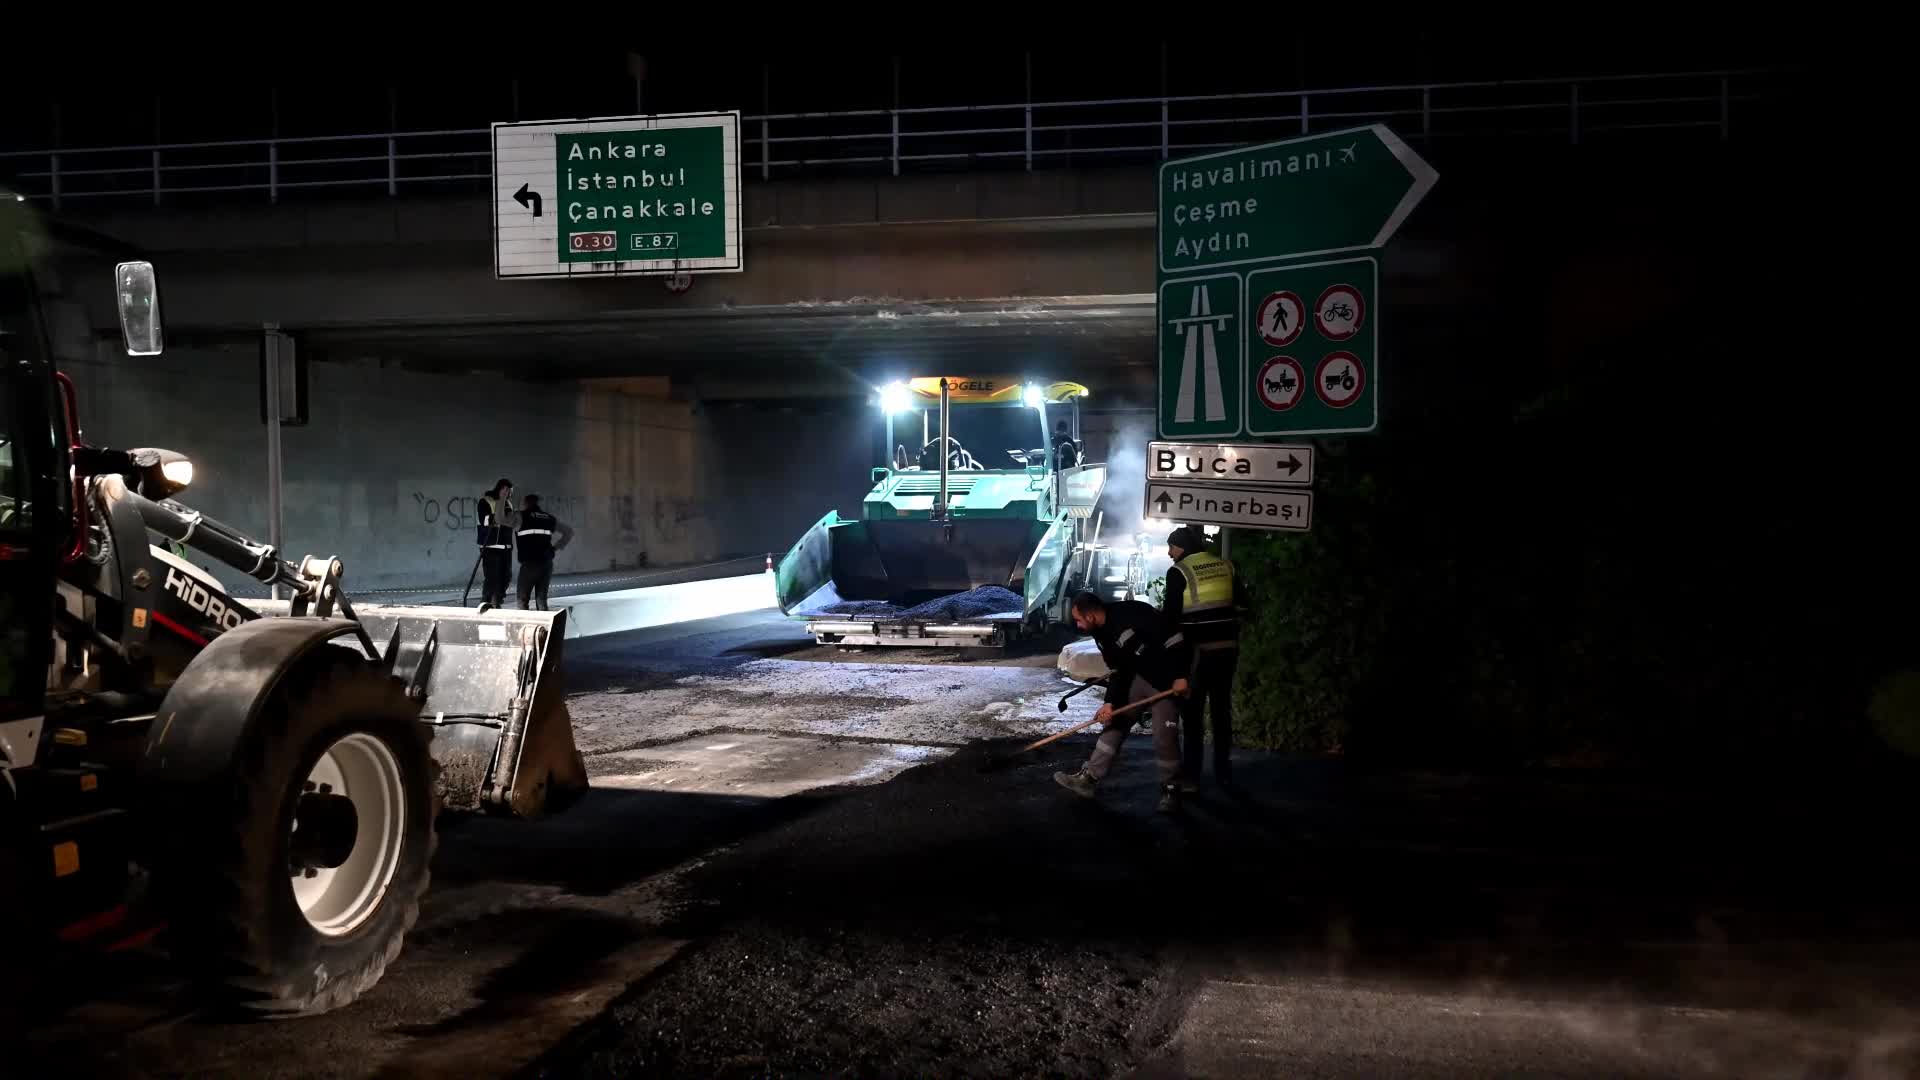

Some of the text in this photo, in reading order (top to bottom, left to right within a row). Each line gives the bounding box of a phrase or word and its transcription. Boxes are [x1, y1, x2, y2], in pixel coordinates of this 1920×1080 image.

[568, 141, 667, 161] Ankara
[567, 168, 685, 190] İstanbul
[1173, 150, 1331, 192] Havalimanı
[568, 198, 715, 223] Çanakkale
[1173, 198, 1258, 226] Çeşme
[635, 235, 674, 248] E.87
[1174, 232, 1250, 259] Aydın
[947, 379, 993, 391] ÖGELE
[1157, 450, 1251, 474] Buca
[1178, 493, 1301, 520] Pınarbaşı
